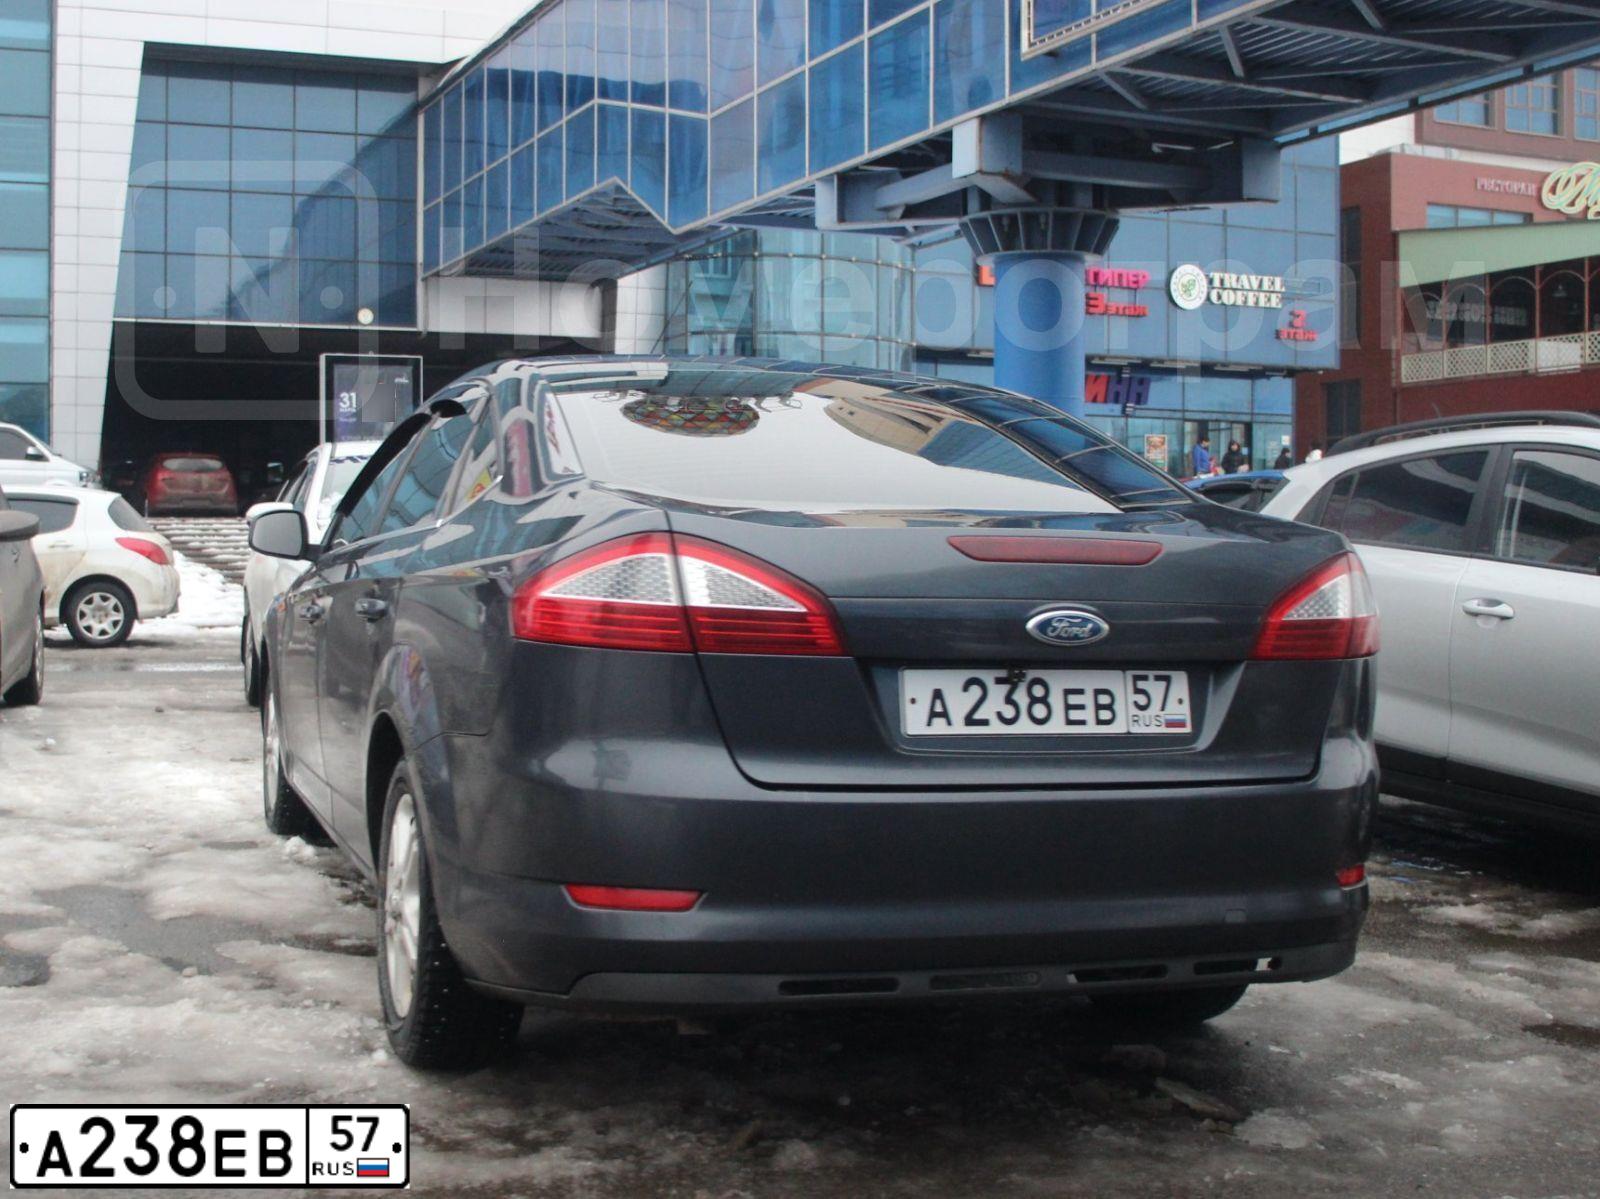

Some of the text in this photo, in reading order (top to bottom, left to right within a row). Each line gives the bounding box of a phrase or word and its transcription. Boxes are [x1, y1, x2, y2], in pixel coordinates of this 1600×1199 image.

[1209, 272, 1286, 292] TRAVEL
[1209, 289, 1283, 309] COFFEE
[339, 391, 357, 409] 31
[1046, 617, 1093, 639] Ford
[926, 674, 1173, 727] А238ЕВ 57
[1131, 714, 1163, 728] RUS
